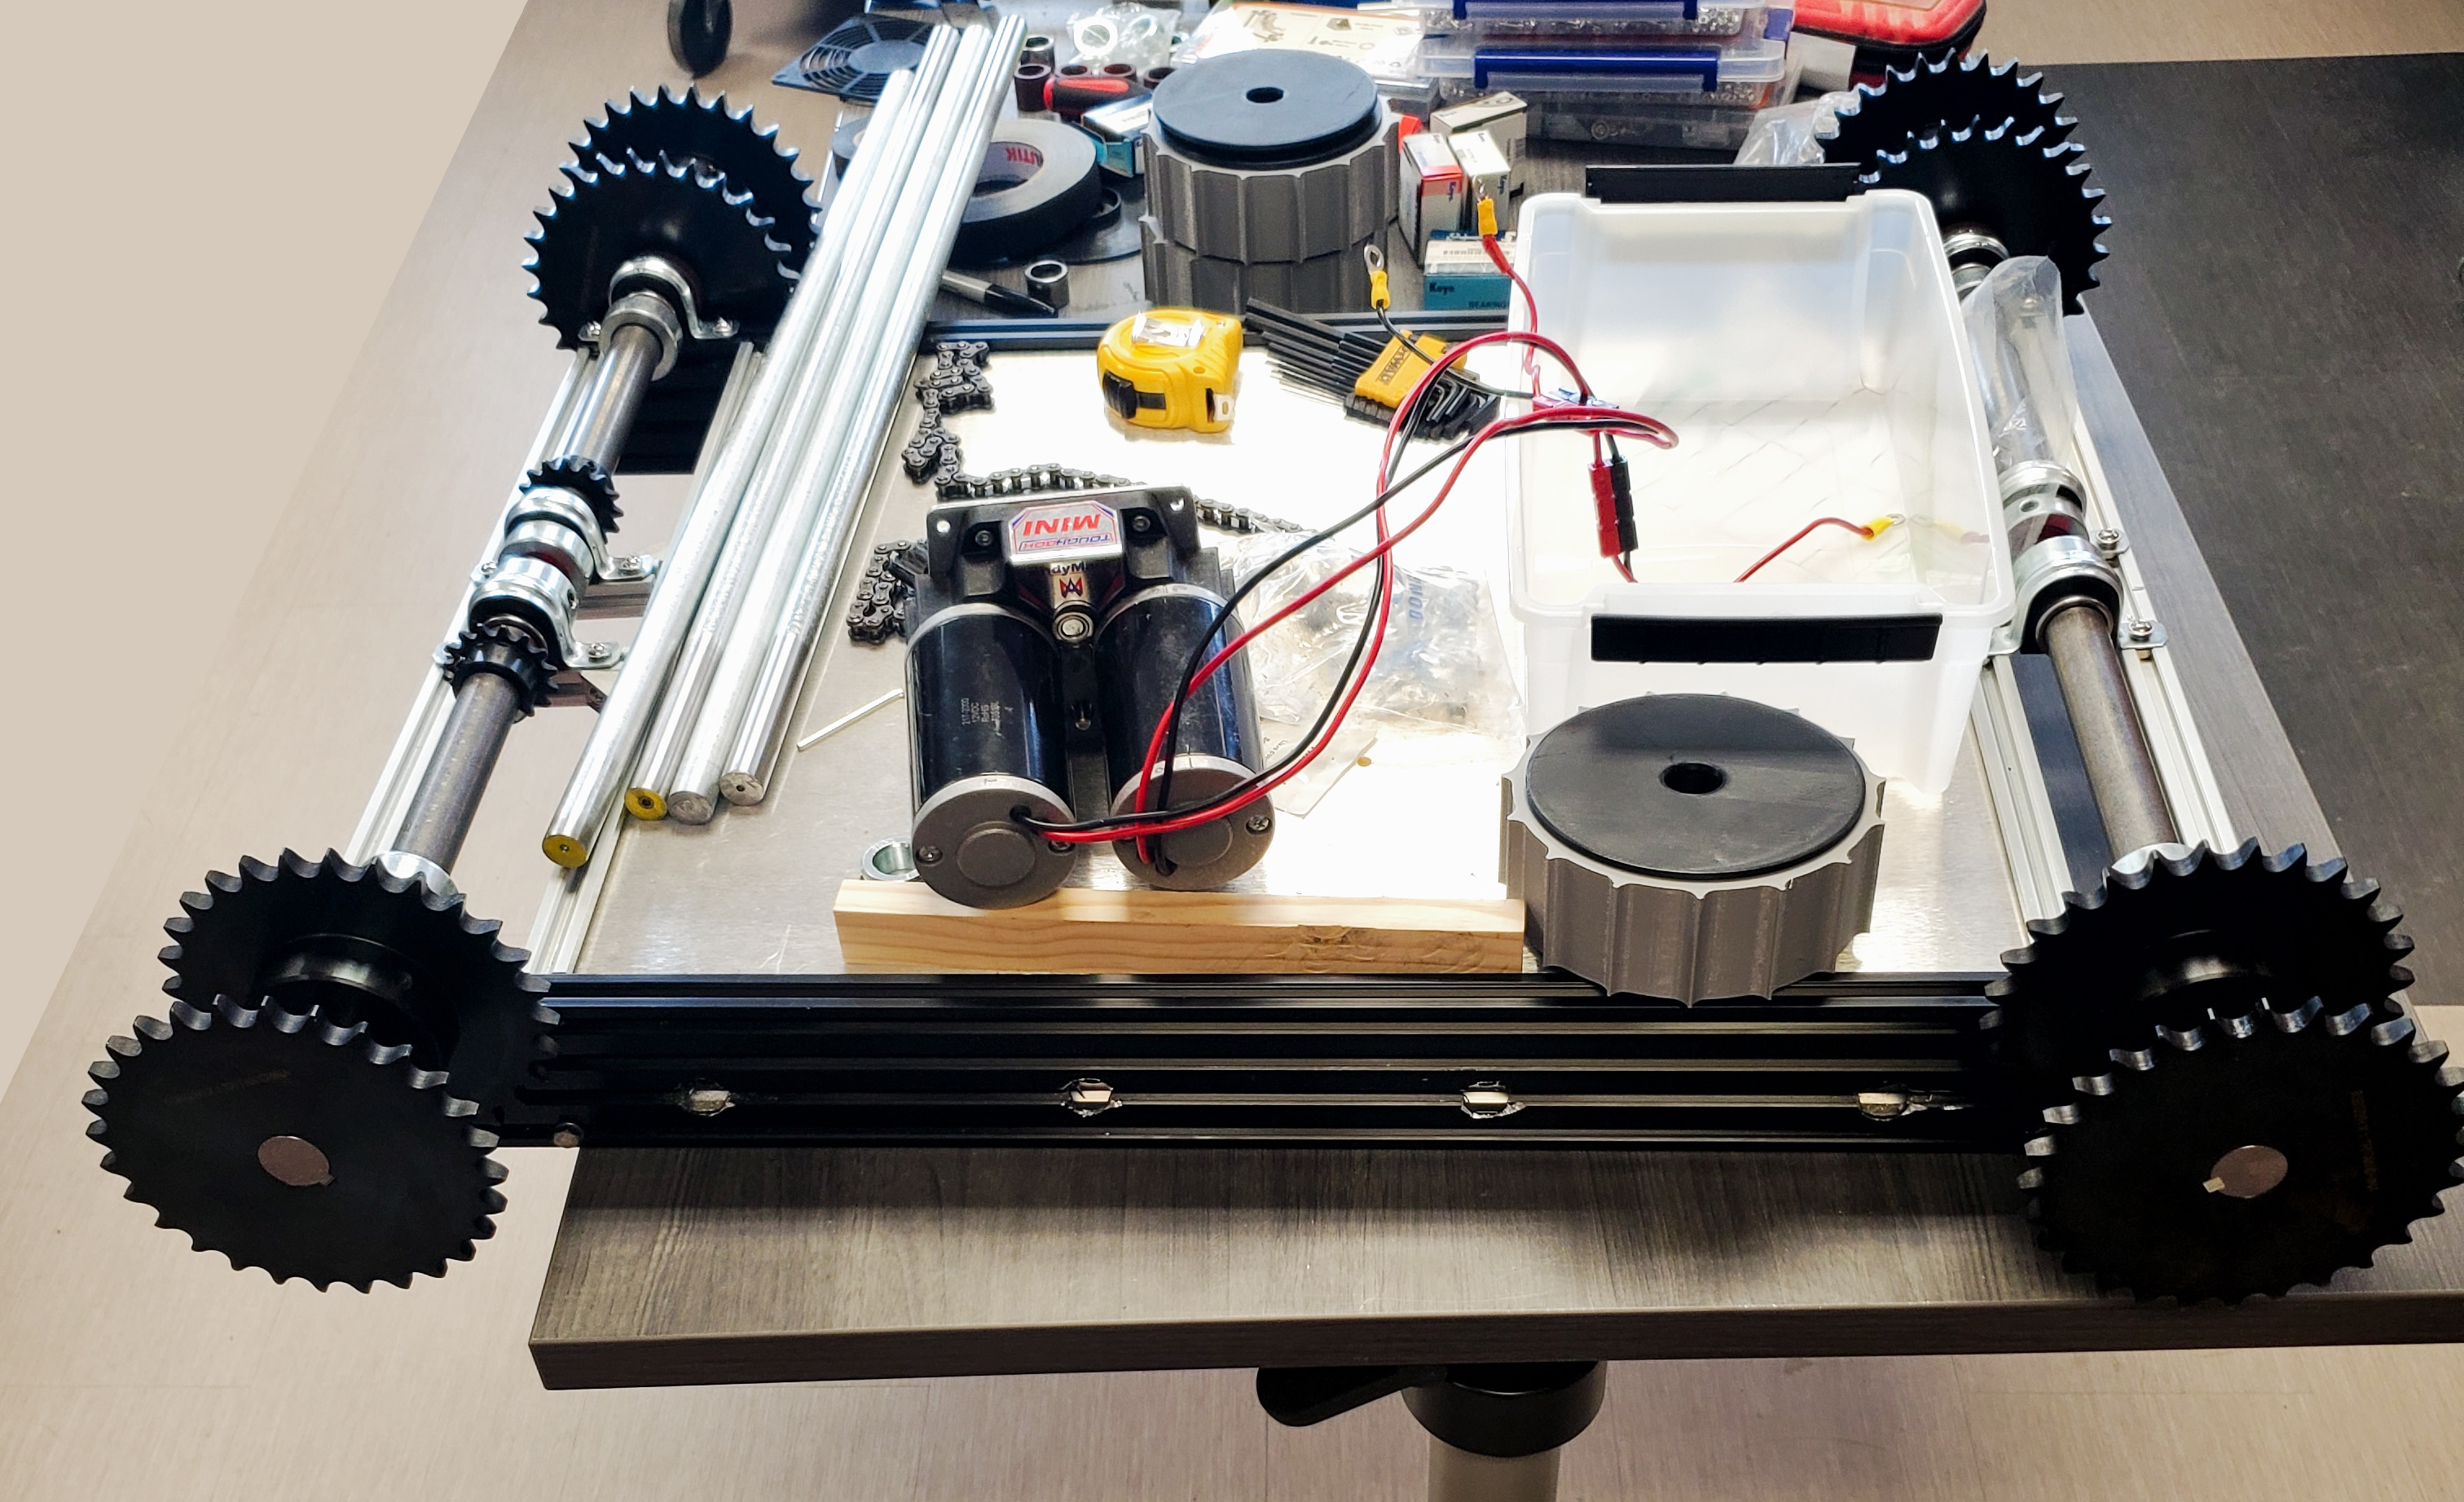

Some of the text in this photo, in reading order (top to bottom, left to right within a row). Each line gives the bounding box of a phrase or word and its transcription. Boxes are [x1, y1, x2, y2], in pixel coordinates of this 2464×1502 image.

[1429, 282, 1454, 296] Koyo
[1023, 513, 1101, 536] MINI
[1023, 534, 1111, 550] TOUGHBOX
